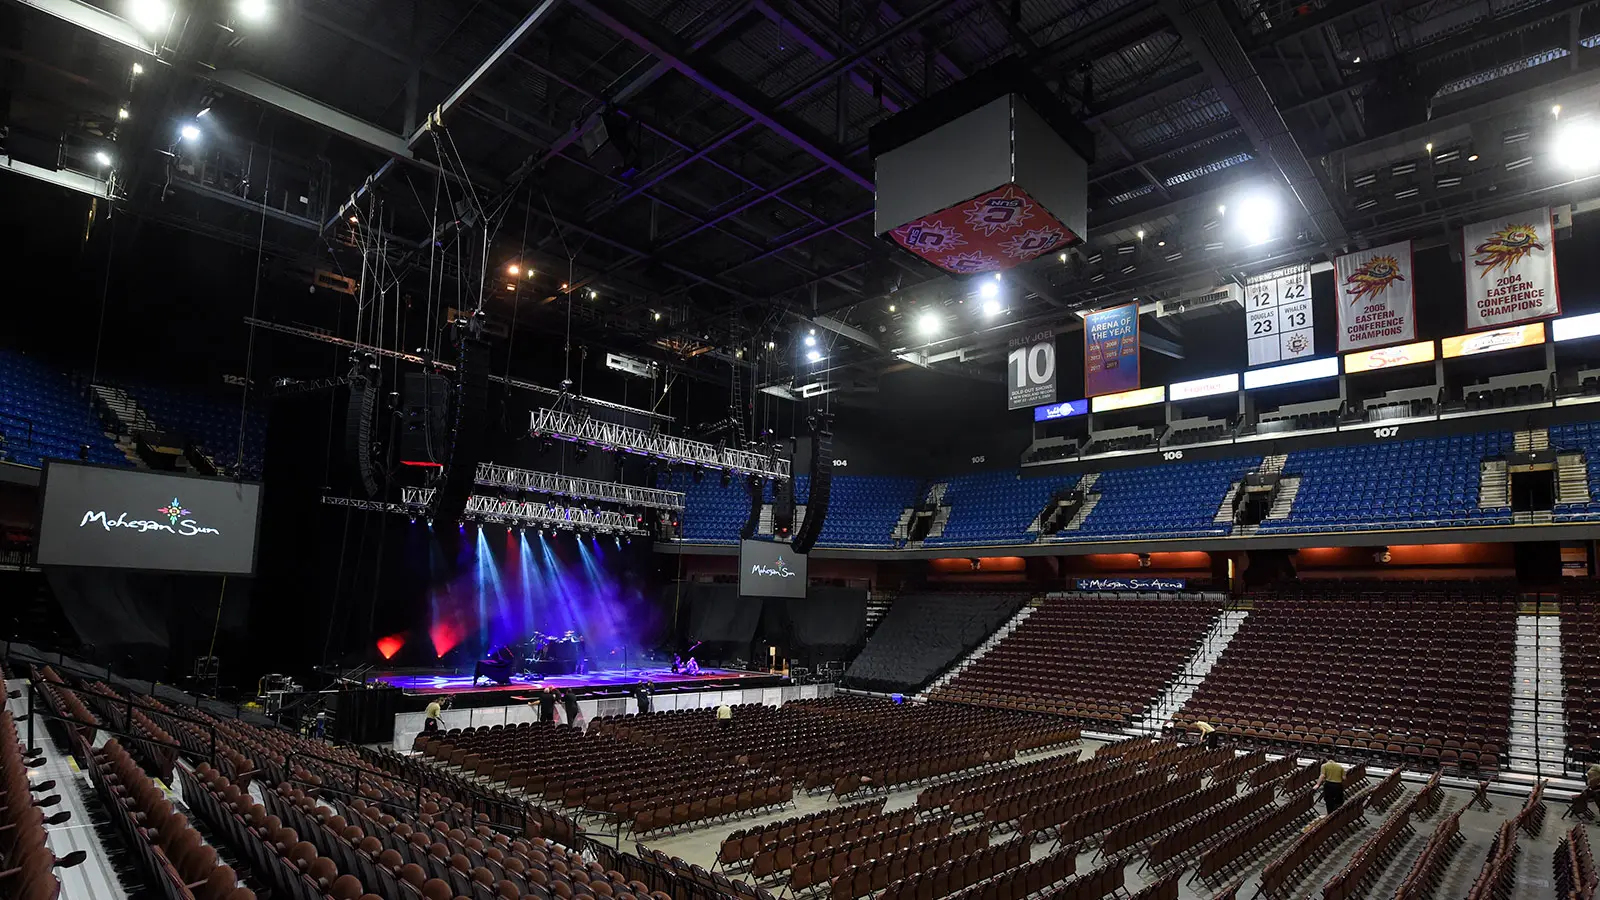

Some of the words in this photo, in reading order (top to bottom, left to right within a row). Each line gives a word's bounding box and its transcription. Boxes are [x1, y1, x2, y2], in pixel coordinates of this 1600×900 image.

[1272, 270, 1283, 278] SUN
[1286, 276, 1302, 285] SALES
[1497, 274, 1522, 287] 2004
[1285, 285, 1305, 299] 42
[1487, 281, 1533, 297] EASTERN
[1253, 293, 1270, 307] 12
[1477, 289, 1544, 309] CONFERENCE
[1284, 304, 1307, 314] WHALEN
[1364, 303, 1385, 314] 2005
[1480, 299, 1542, 317] CHAMPIONS
[1251, 311, 1274, 321] DOUGLAS
[1287, 312, 1306, 327] 13
[1356, 310, 1394, 323] EASTERN
[1091, 320, 1118, 332] ARENA
[1121, 317, 1131, 325] OF
[1254, 320, 1272, 335] 23
[1348, 317, 1404, 334] CONFERENCE
[1009, 336, 1030, 347] BILLY
[1032, 330, 1054, 341] JOEL
[1092, 331, 1107, 340] THE
[1109, 326, 1131, 337] YEAR
[1350, 327, 1402, 342] CHAMPIONS
[1009, 342, 1055, 387] 10
[1374, 426, 1399, 438] 107
[1163, 451, 1182, 460] 106
[832, 459, 847, 467] 104
[80, 510, 175, 533] Mohegan
[178, 520, 220, 535] Sun
[782, 567, 796, 577] Sun
[1090, 579, 1129, 589] Mohegan
[1130, 580, 1149, 589] Sun
[1151, 579, 1182, 589] Arena
